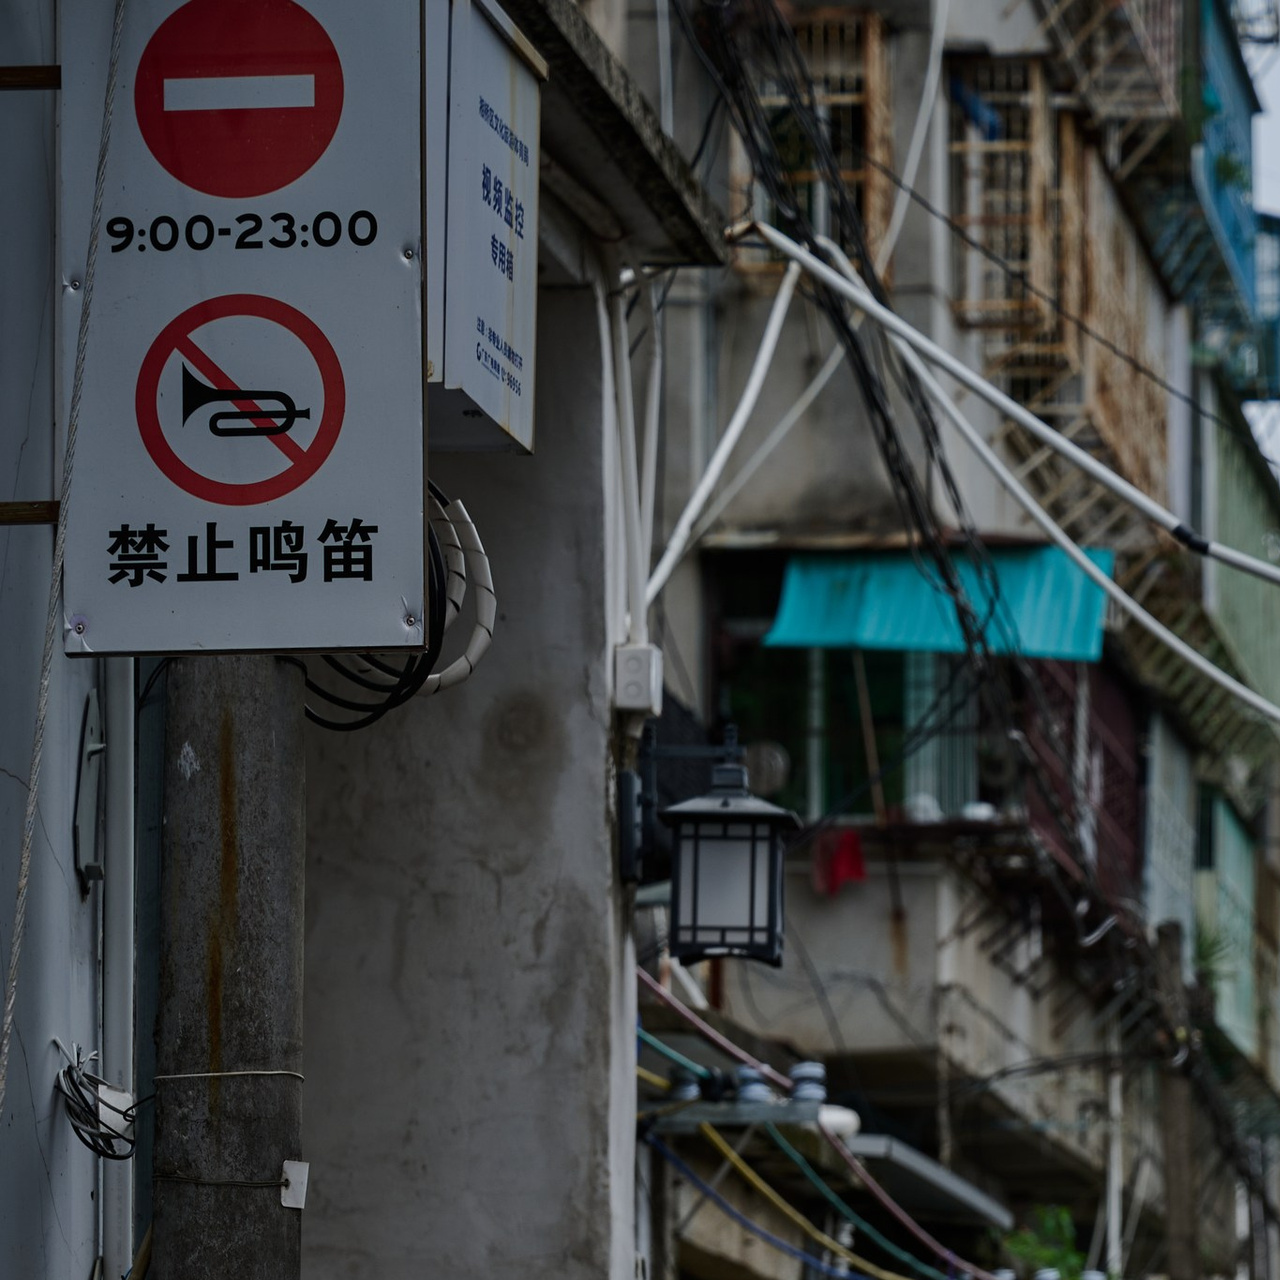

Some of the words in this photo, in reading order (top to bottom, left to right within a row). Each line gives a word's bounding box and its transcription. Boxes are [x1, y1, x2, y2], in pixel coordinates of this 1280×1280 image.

[482, 163, 524, 239] 视频监控
[106, 210, 378, 253] 9:00-23:00
[491, 233, 513, 281] 专用箱
[106, 518, 378, 587] 禁止鸣笛
